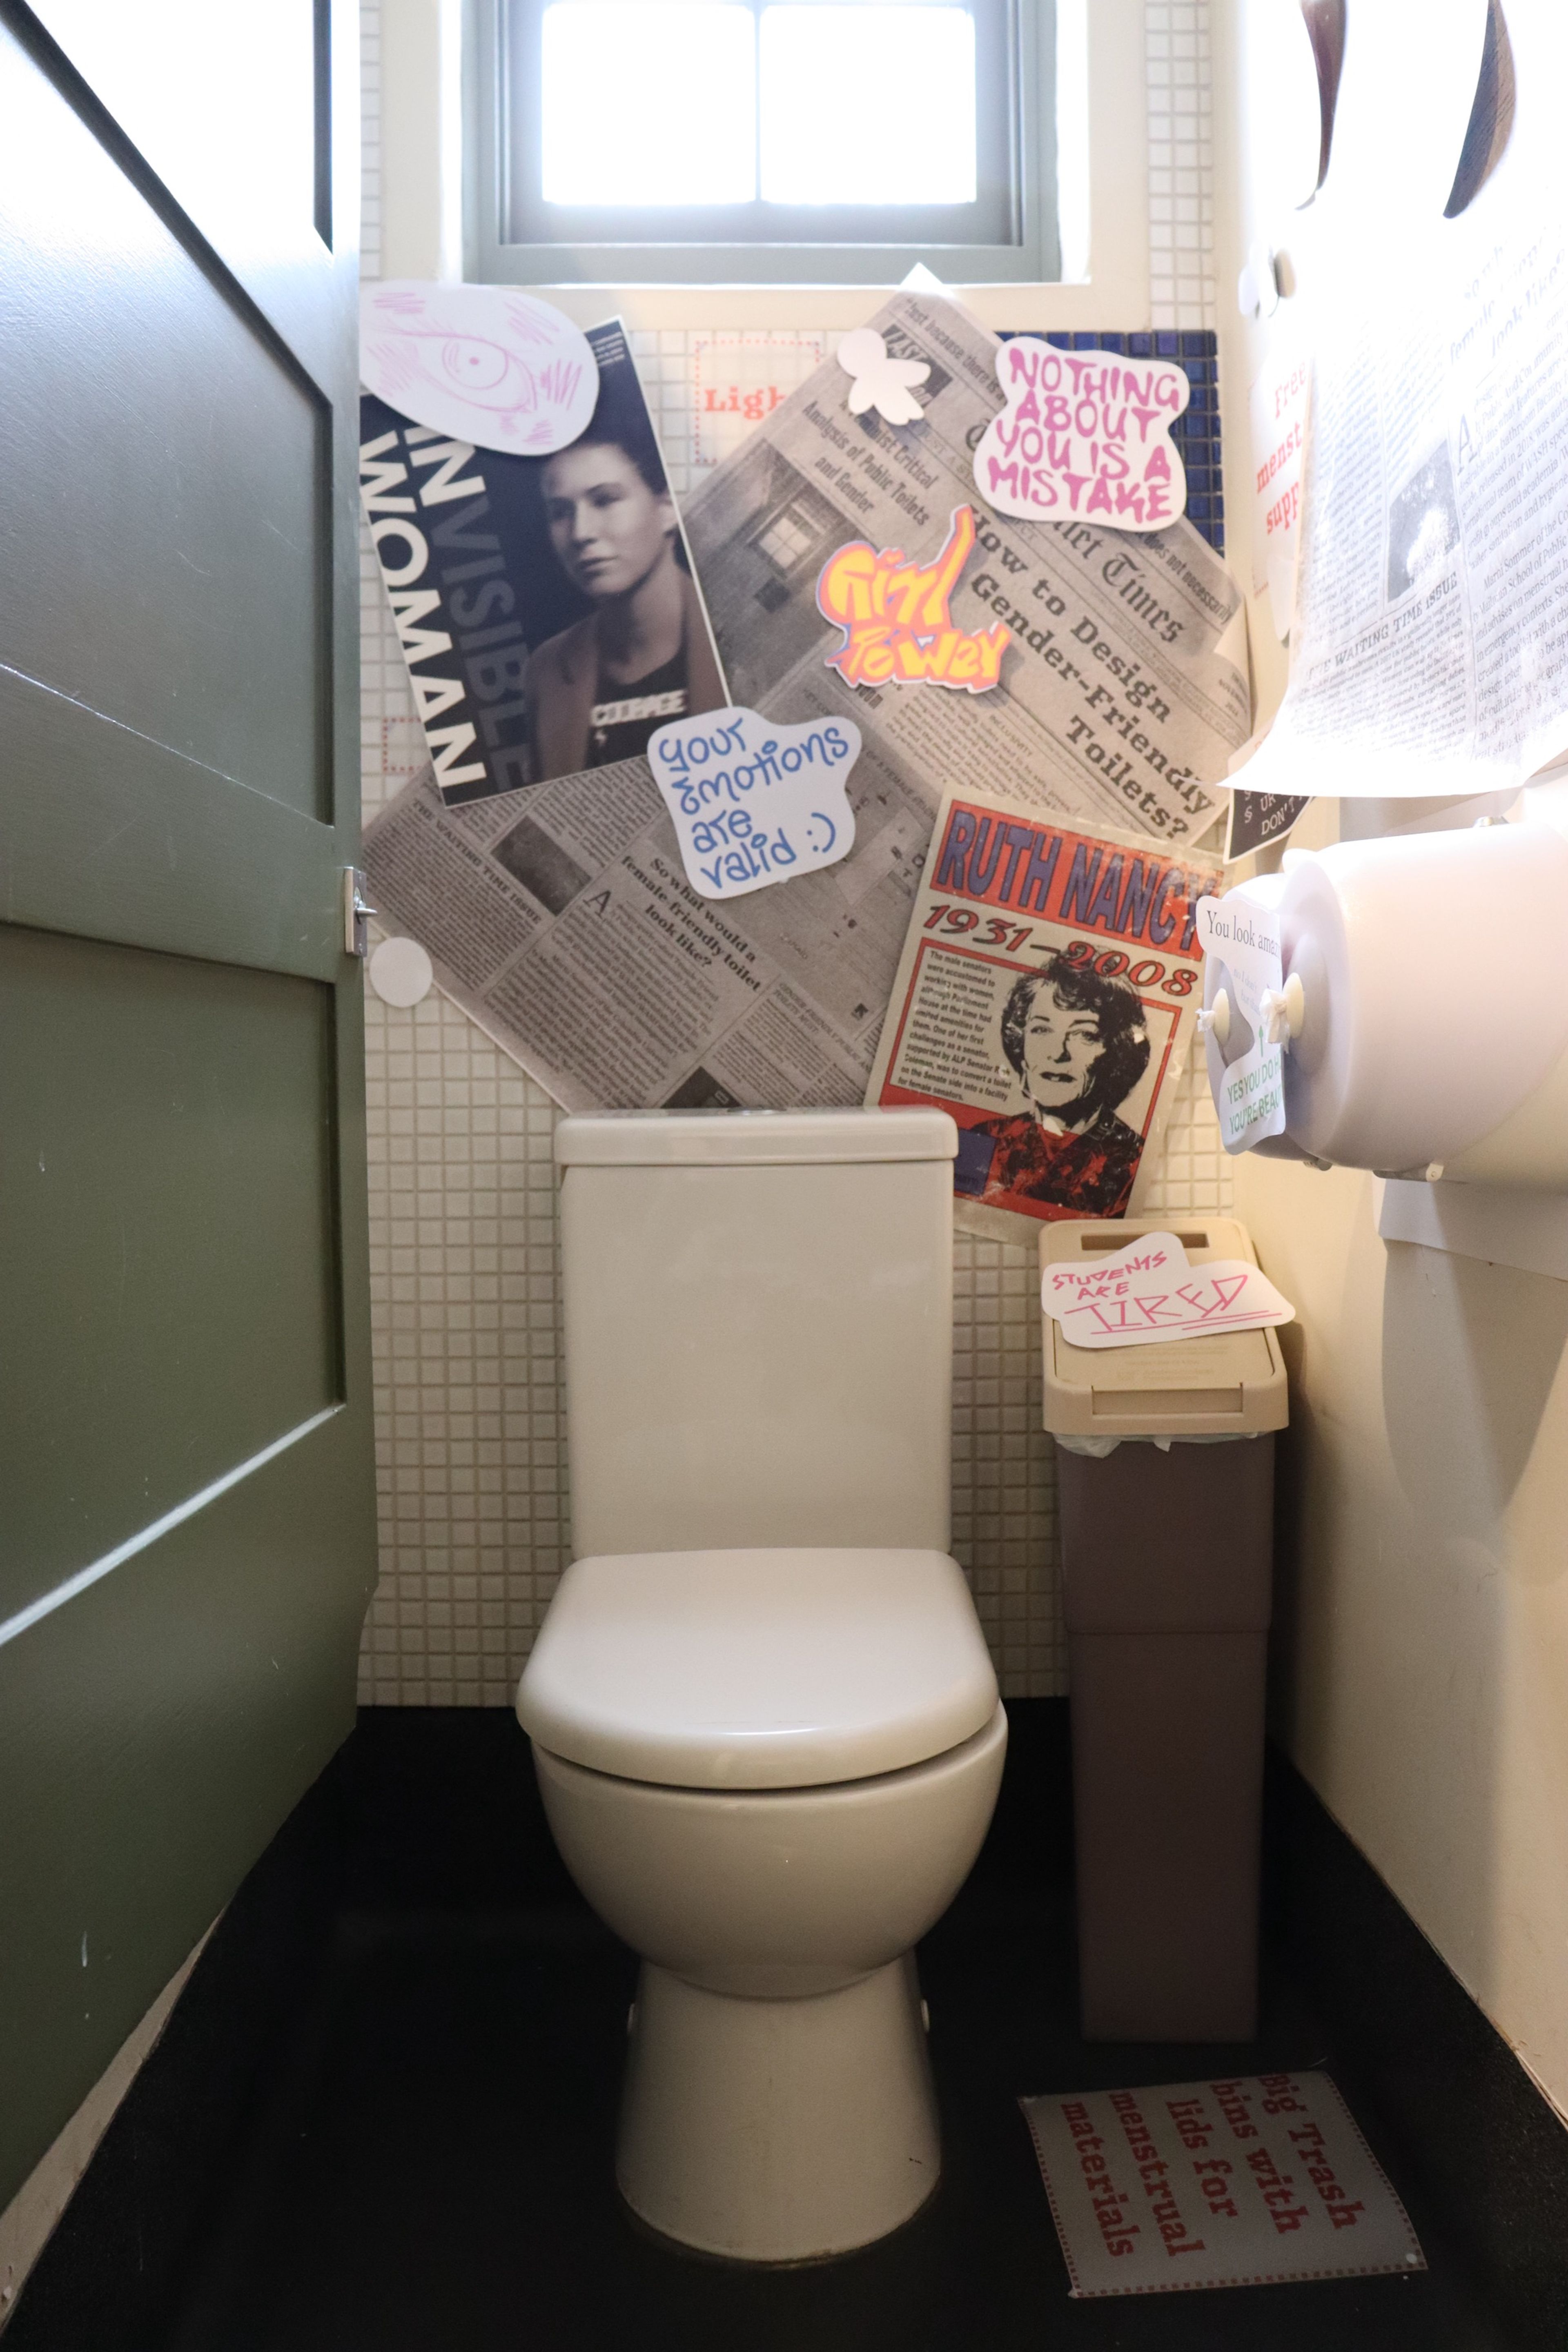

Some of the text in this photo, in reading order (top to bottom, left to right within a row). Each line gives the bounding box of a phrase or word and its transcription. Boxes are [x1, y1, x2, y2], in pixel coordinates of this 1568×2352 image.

[925, 320, 964, 359] because
[963, 355, 989, 383] there
[1009, 347, 1180, 411] NOTHING
[1016, 390, 1161, 442] ABOUT
[1274, 361, 1307, 420] Free
[995, 418, 1071, 470] YOU
[1090, 442, 1130, 480] IS
[1145, 445, 1171, 482] A
[1479, 417, 1550, 495] released in was
[1500, 407, 1536, 450] bathroom
[802, 400, 849, 449] Analysis
[846, 445, 864, 463] of
[858, 454, 893, 491] Public
[891, 481, 930, 526] Toilets
[813, 457, 875, 514] and Gender
[893, 445, 941, 490] Critical
[988, 456, 1173, 523] MISTAKE
[1498, 463, 1526, 499] team of
[1507, 458, 1559, 513] and academia
[1523, 499, 1539, 521] and
[1484, 522, 1557, 591] Marni Sommer of the
[1508, 535, 1567, 593] School of Public
[361, 430, 488, 788] WOMAN
[1101, 551, 1187, 644] Times
[1166, 554, 1187, 575] not
[1182, 570, 1234, 625] necessarily
[1334, 570, 1458, 667] WAITING TIME ISSUE
[1475, 562, 1562, 643] and advises menstrual
[1031, 577, 1067, 617] to
[1070, 615, 1173, 724] Design
[1477, 595, 1554, 663] in emergency contexts.
[1477, 647, 1503, 683] created
[1533, 620, 1550, 639] with
[971, 572, 1215, 825] Gender-Friendly
[658, 717, 747, 773] your
[679, 727, 849, 816] emotions
[1065, 713, 1190, 840] Toilets?
[692, 809, 753, 853] are
[1260, 796, 1295, 836] DON'T
[436, 819, 483, 868] WAITING
[483, 865, 510, 894] TIME
[510, 892, 542, 925] ISSUE
[700, 826, 797, 890] valid
[936, 809, 1217, 952] RUTH NANCY
[583, 889, 612, 920] A
[650, 858, 670, 878] So
[669, 876, 705, 913] what
[704, 909, 748, 954] would
[745, 951, 756, 964] a
[1206, 910, 1229, 938] You
[1233, 915, 1256, 947] look
[645, 903, 713, 968] look like?
[931, 951, 992, 974] The male senators
[724, 953, 762, 992] toilet
[927, 964, 996, 987] were accustomed to
[952, 982, 968, 992] with
[913, 1020, 931, 1031] them.
[933, 1025, 947, 1035] One
[957, 1031, 969, 1041] her
[969, 1033, 984, 1045] first
[918, 997, 993, 1023] House at the time had
[940, 1016, 984, 1033] amenities for
[906, 1043, 993, 1072] supported by ALP Senator
[909, 1031, 990, 1060] challenges as a senator,
[898, 1076, 964, 1101] for female senators.
[900, 1065, 1009, 1102] on the Senate side into facility
[936, 1063, 950, 1072] was
[951, 1067, 959, 1075] to
[960, 1069, 987, 1083] convert
[993, 1077, 1012, 1089] toilet
[1227, 1079, 1243, 1104] YES
[1243, 1068, 1260, 1096] YOU
[1261, 1059, 1274, 1085] DO
[1229, 1102, 1258, 1135] YOU'RE
[1051, 1250, 1167, 1291] STUDENTS
[1077, 1281, 1129, 1301] ARE
[1063, 1274, 1249, 1330] TIRED
[1060, 2101, 1142, 2258] materials
[1108, 2091, 1207, 2258] menstrual
[1164, 2098, 1239, 2218] lids for
[1209, 2080, 1311, 2235] bins with
[1260, 2073, 1366, 2231] Big Trash
